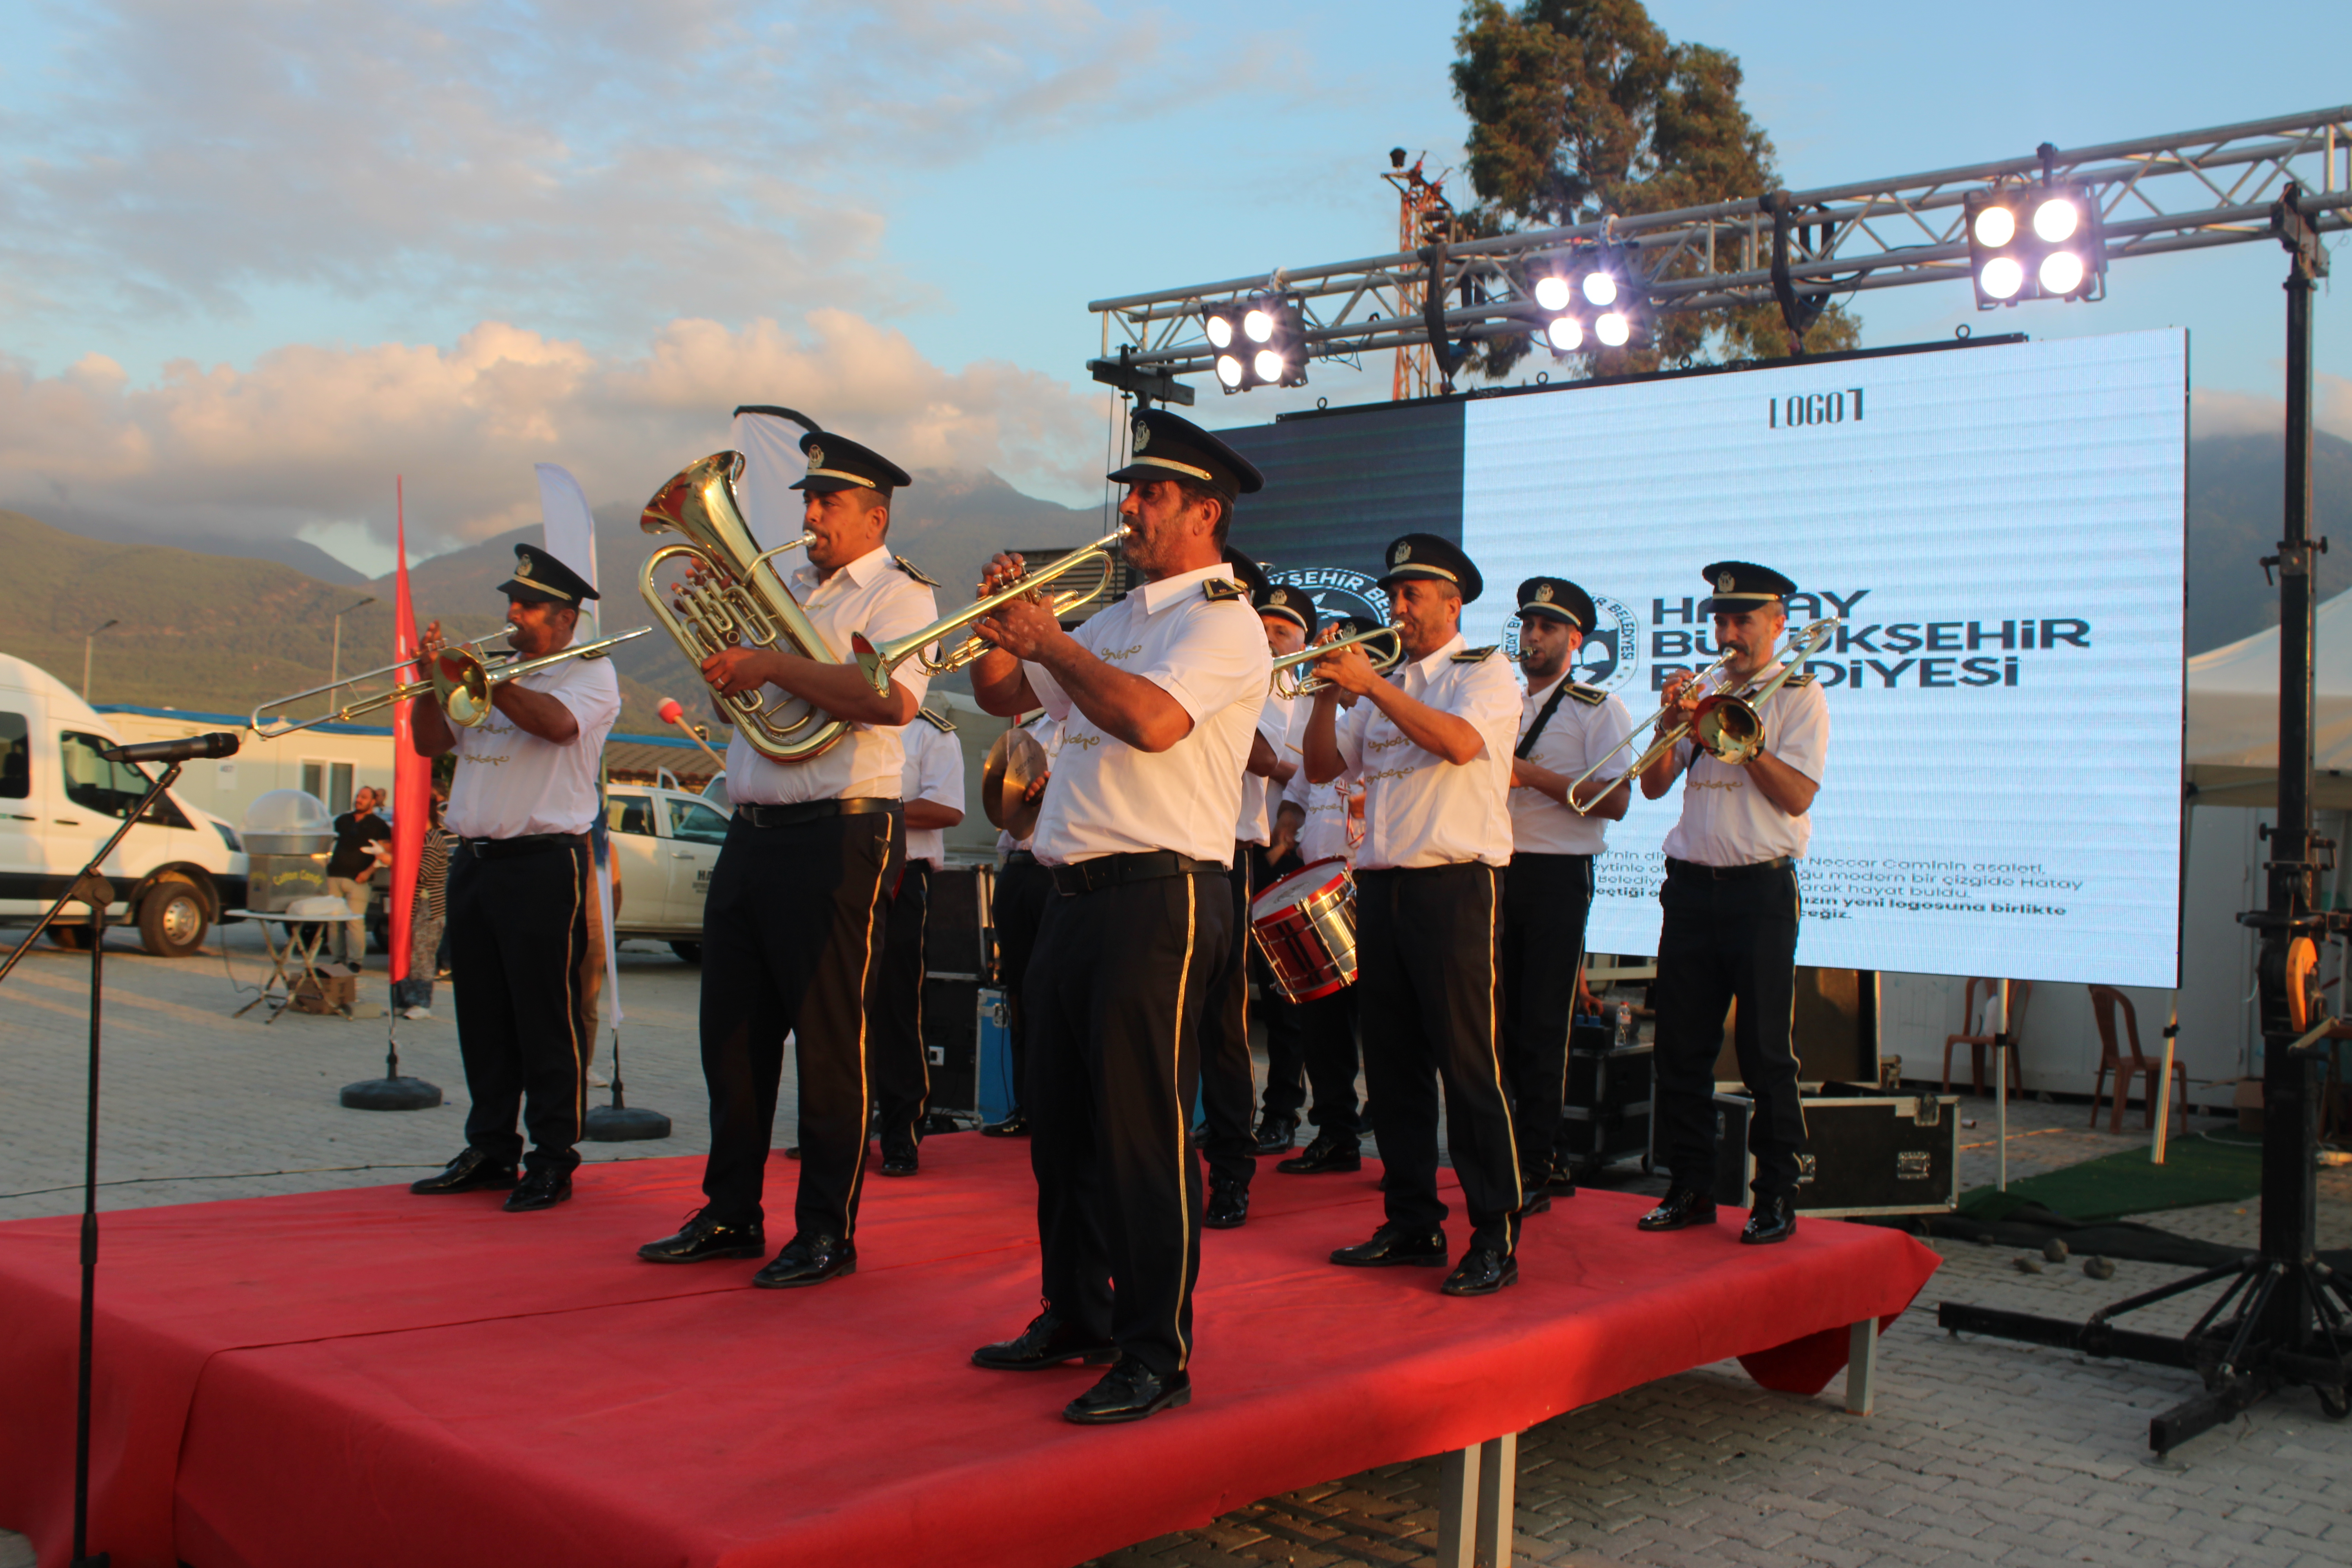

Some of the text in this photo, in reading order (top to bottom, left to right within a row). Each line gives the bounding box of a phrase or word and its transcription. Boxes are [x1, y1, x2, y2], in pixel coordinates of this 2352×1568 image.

[1652, 590, 1870, 624] HAY
[1829, 871, 1905, 882] modern
[1912, 873, 1936, 883] bir
[2021, 878, 2083, 891] Hatay
[1848, 884, 1904, 896] hayat
[1843, 897, 1884, 907] yeni
[1889, 898, 1985, 911] logosuna
[1991, 902, 2067, 915] birlikte
